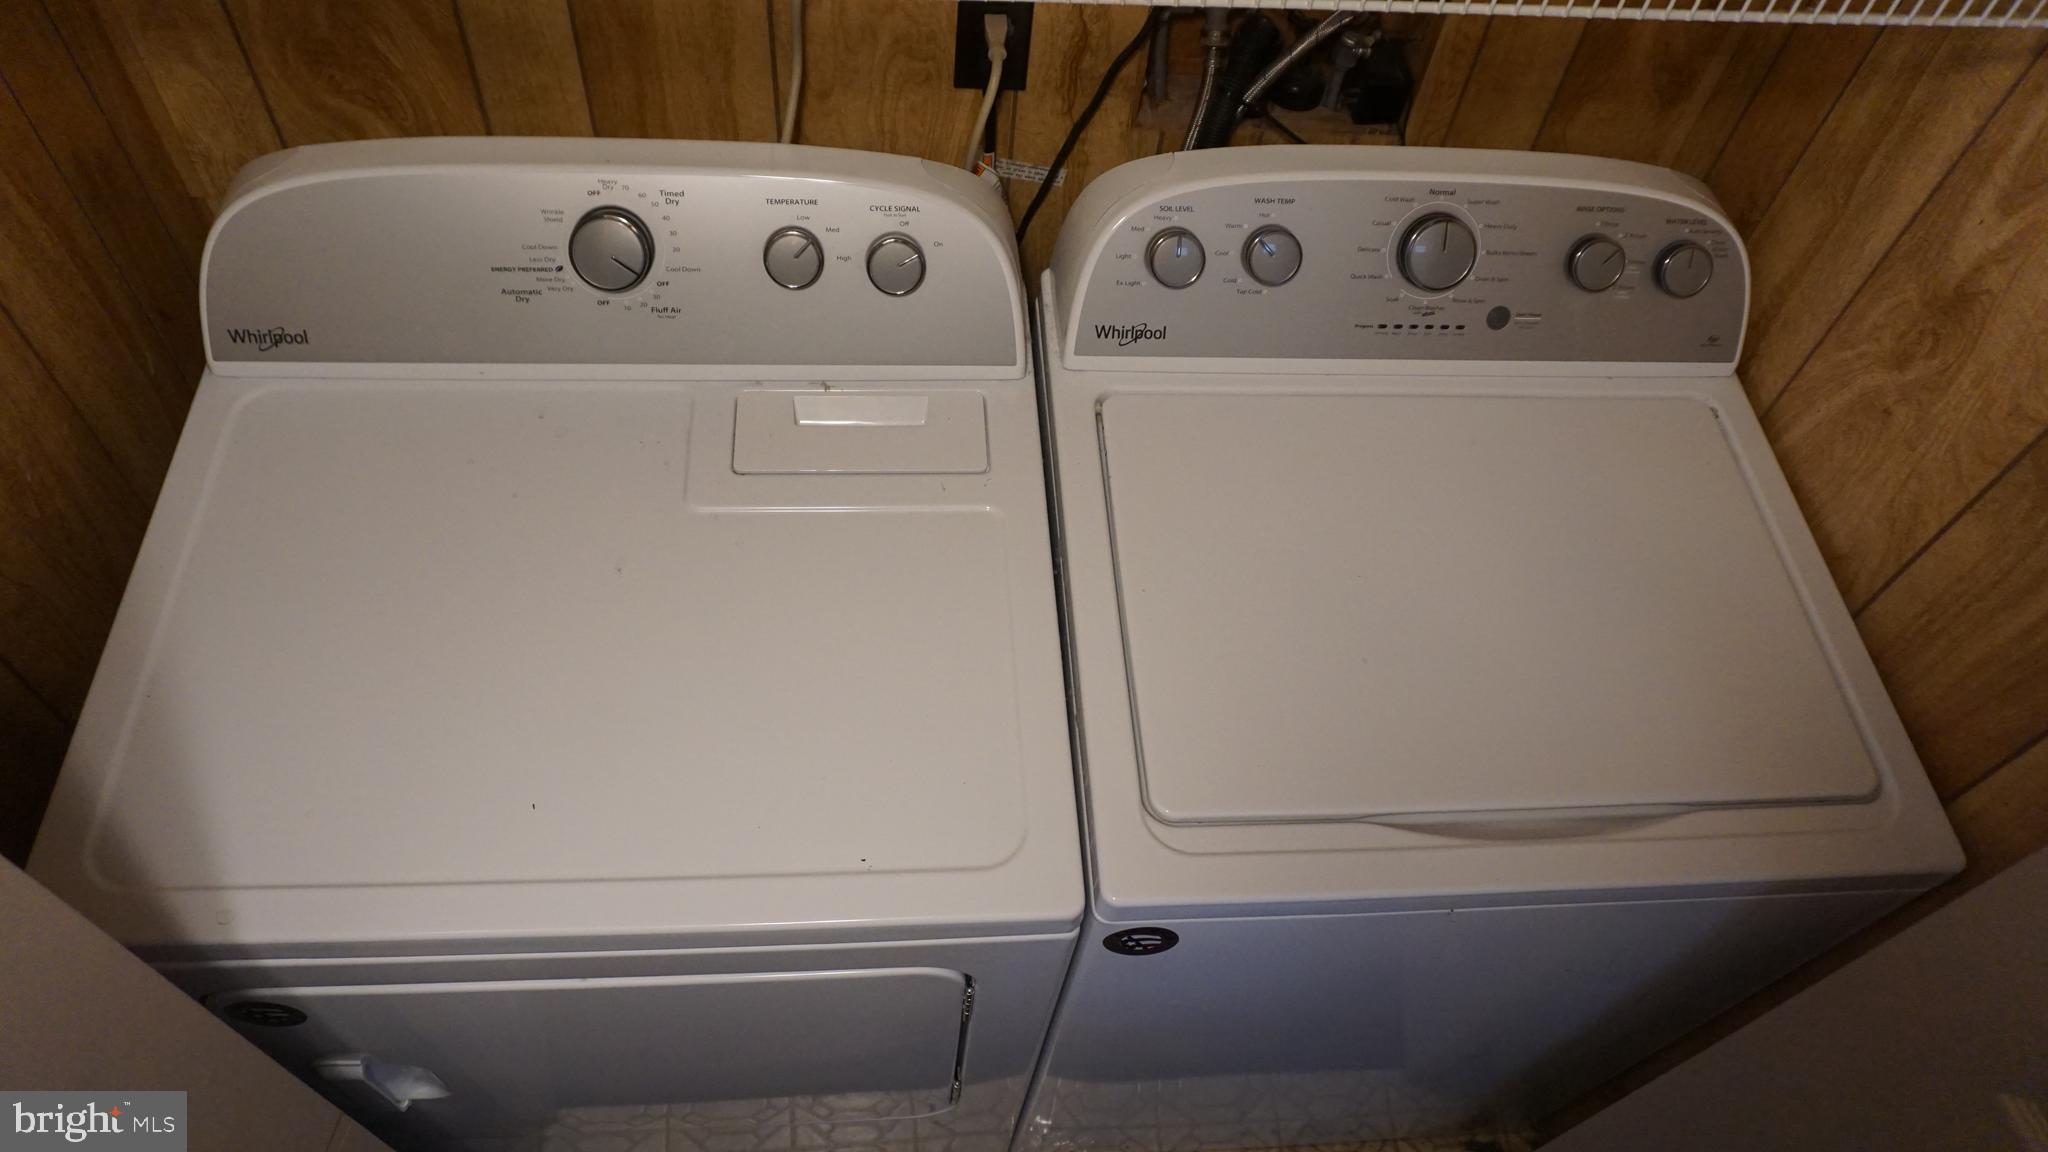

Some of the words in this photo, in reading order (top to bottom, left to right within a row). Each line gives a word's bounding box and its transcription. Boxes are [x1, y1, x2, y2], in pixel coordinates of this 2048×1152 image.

[1429, 187, 1457, 196] Normal
[665, 198, 680, 206] Dry
[766, 198, 819, 206] TEMPERATURE
[1254, 197, 1275, 205] WASH
[869, 204, 893, 212] CYCLE
[894, 205, 921, 213] SIGNAL
[1159, 205, 1174, 213] SOIL
[796, 213, 811, 221] Low
[899, 220, 911, 228] Off
[933, 240, 944, 248] On
[836, 255, 853, 263] High
[1115, 252, 1133, 260] Light
[501, 288, 543, 296] Automatic
[515, 295, 530, 303] Dry
[651, 306, 668, 314] Fluff
[670, 306, 682, 314] Air
[1095, 322, 1167, 347] Whirlpool
[226, 326, 309, 352] Whirlpool
